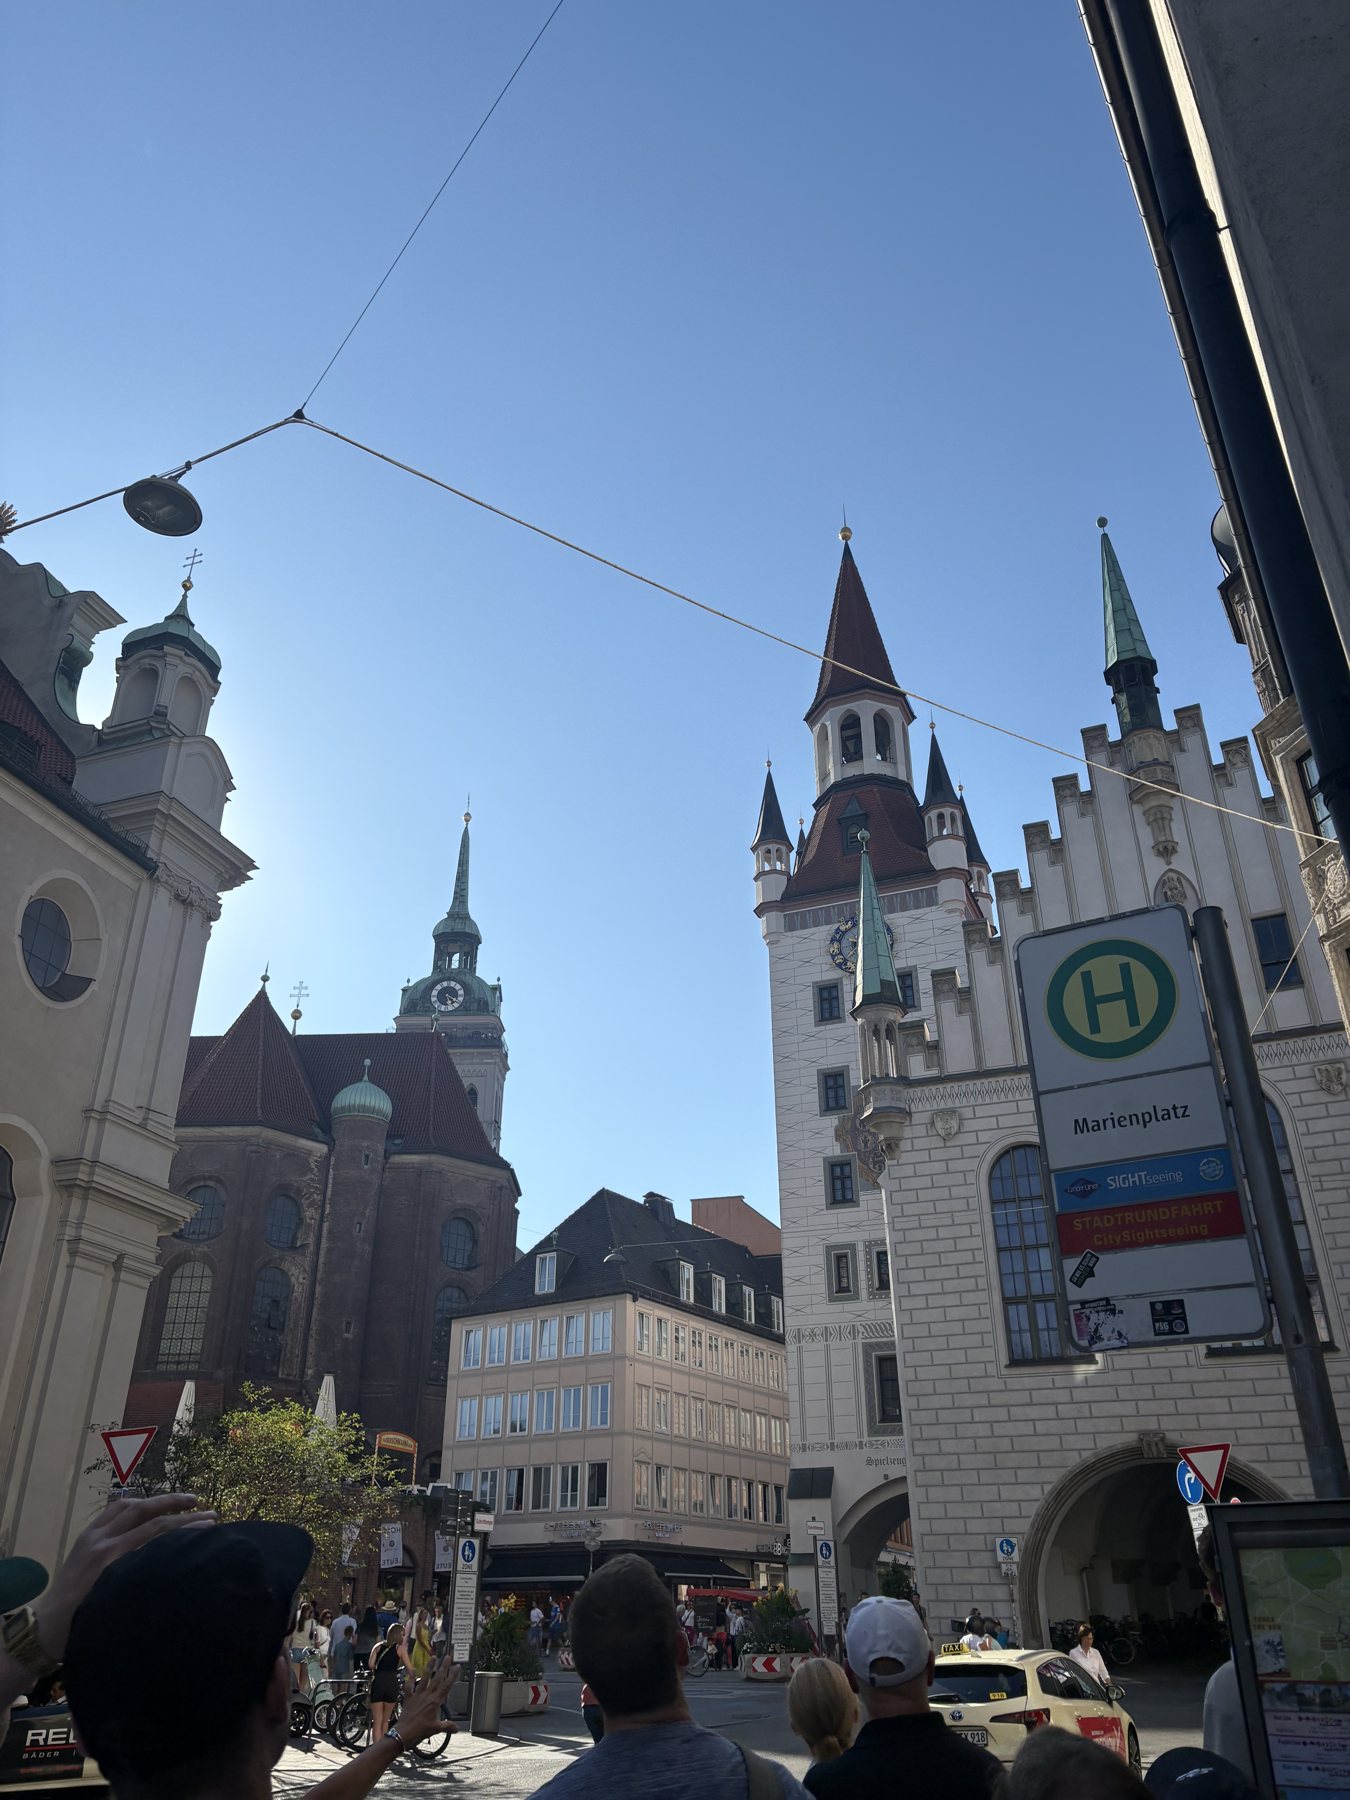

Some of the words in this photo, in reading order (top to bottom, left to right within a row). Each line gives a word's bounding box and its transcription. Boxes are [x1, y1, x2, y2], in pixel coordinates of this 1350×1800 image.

[1080, 962, 1141, 1035] H
[1072, 1103, 1191, 1136] Marienplatz
[1106, 1170, 1184, 1190] SIGHTseeing
[1072, 1200, 1225, 1231] STADTRUNDFAHRT
[1092, 1222, 1209, 1247] CitySightseeing
[944, 1644, 963, 1652] TAXI
[970, 1732, 986, 1744] 918
